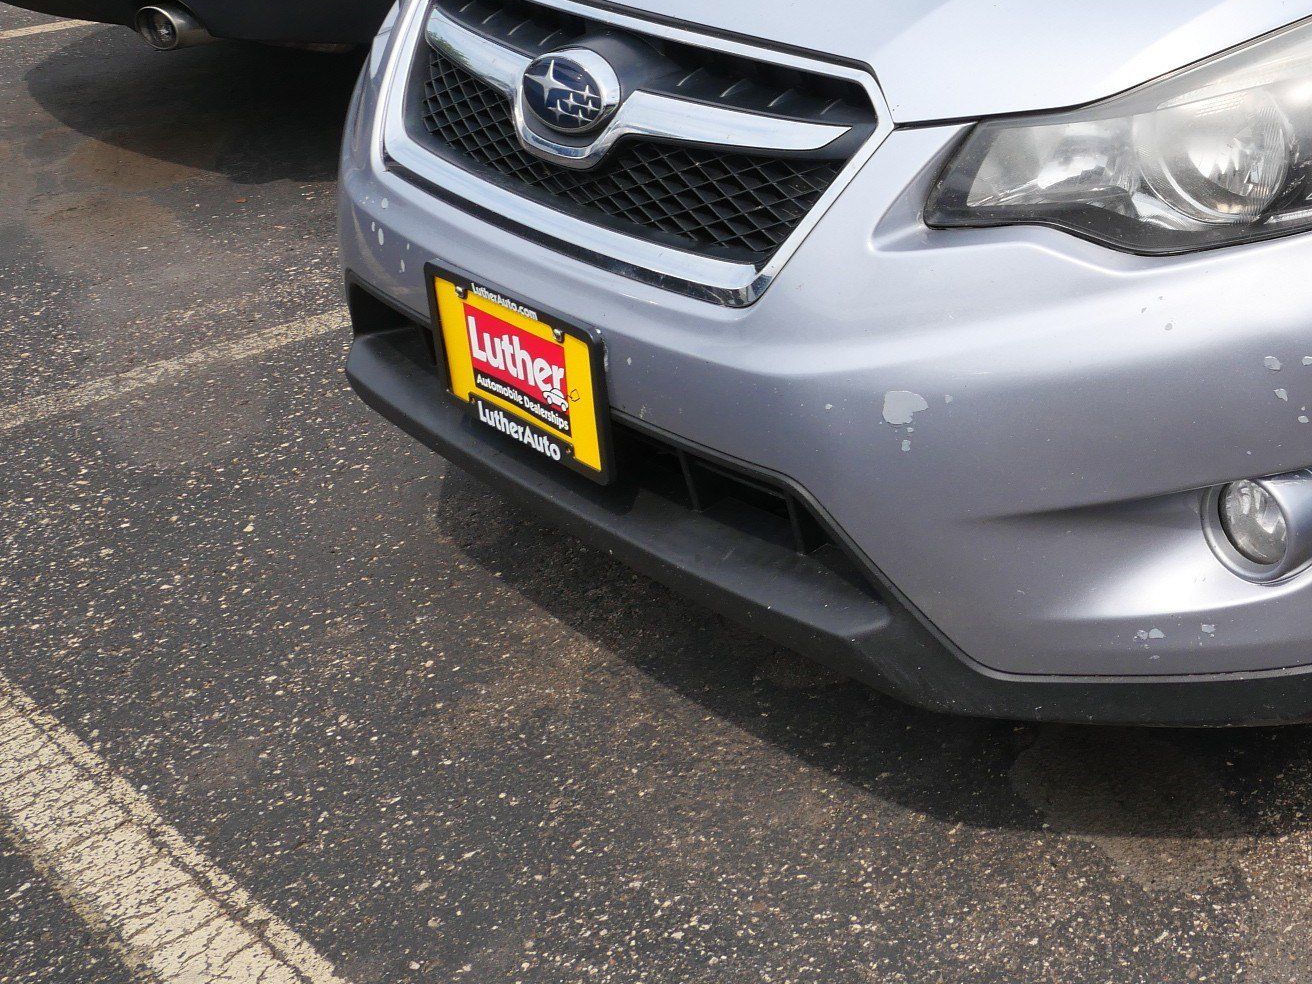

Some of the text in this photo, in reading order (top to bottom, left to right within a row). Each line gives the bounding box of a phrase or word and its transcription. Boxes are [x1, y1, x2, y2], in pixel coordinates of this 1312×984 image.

[471, 282, 538, 321] LutherAuto.com
[467, 315, 565, 390] Luther
[476, 374, 569, 431] Automobile Dealerships
[477, 400, 561, 462] LutherAuto
